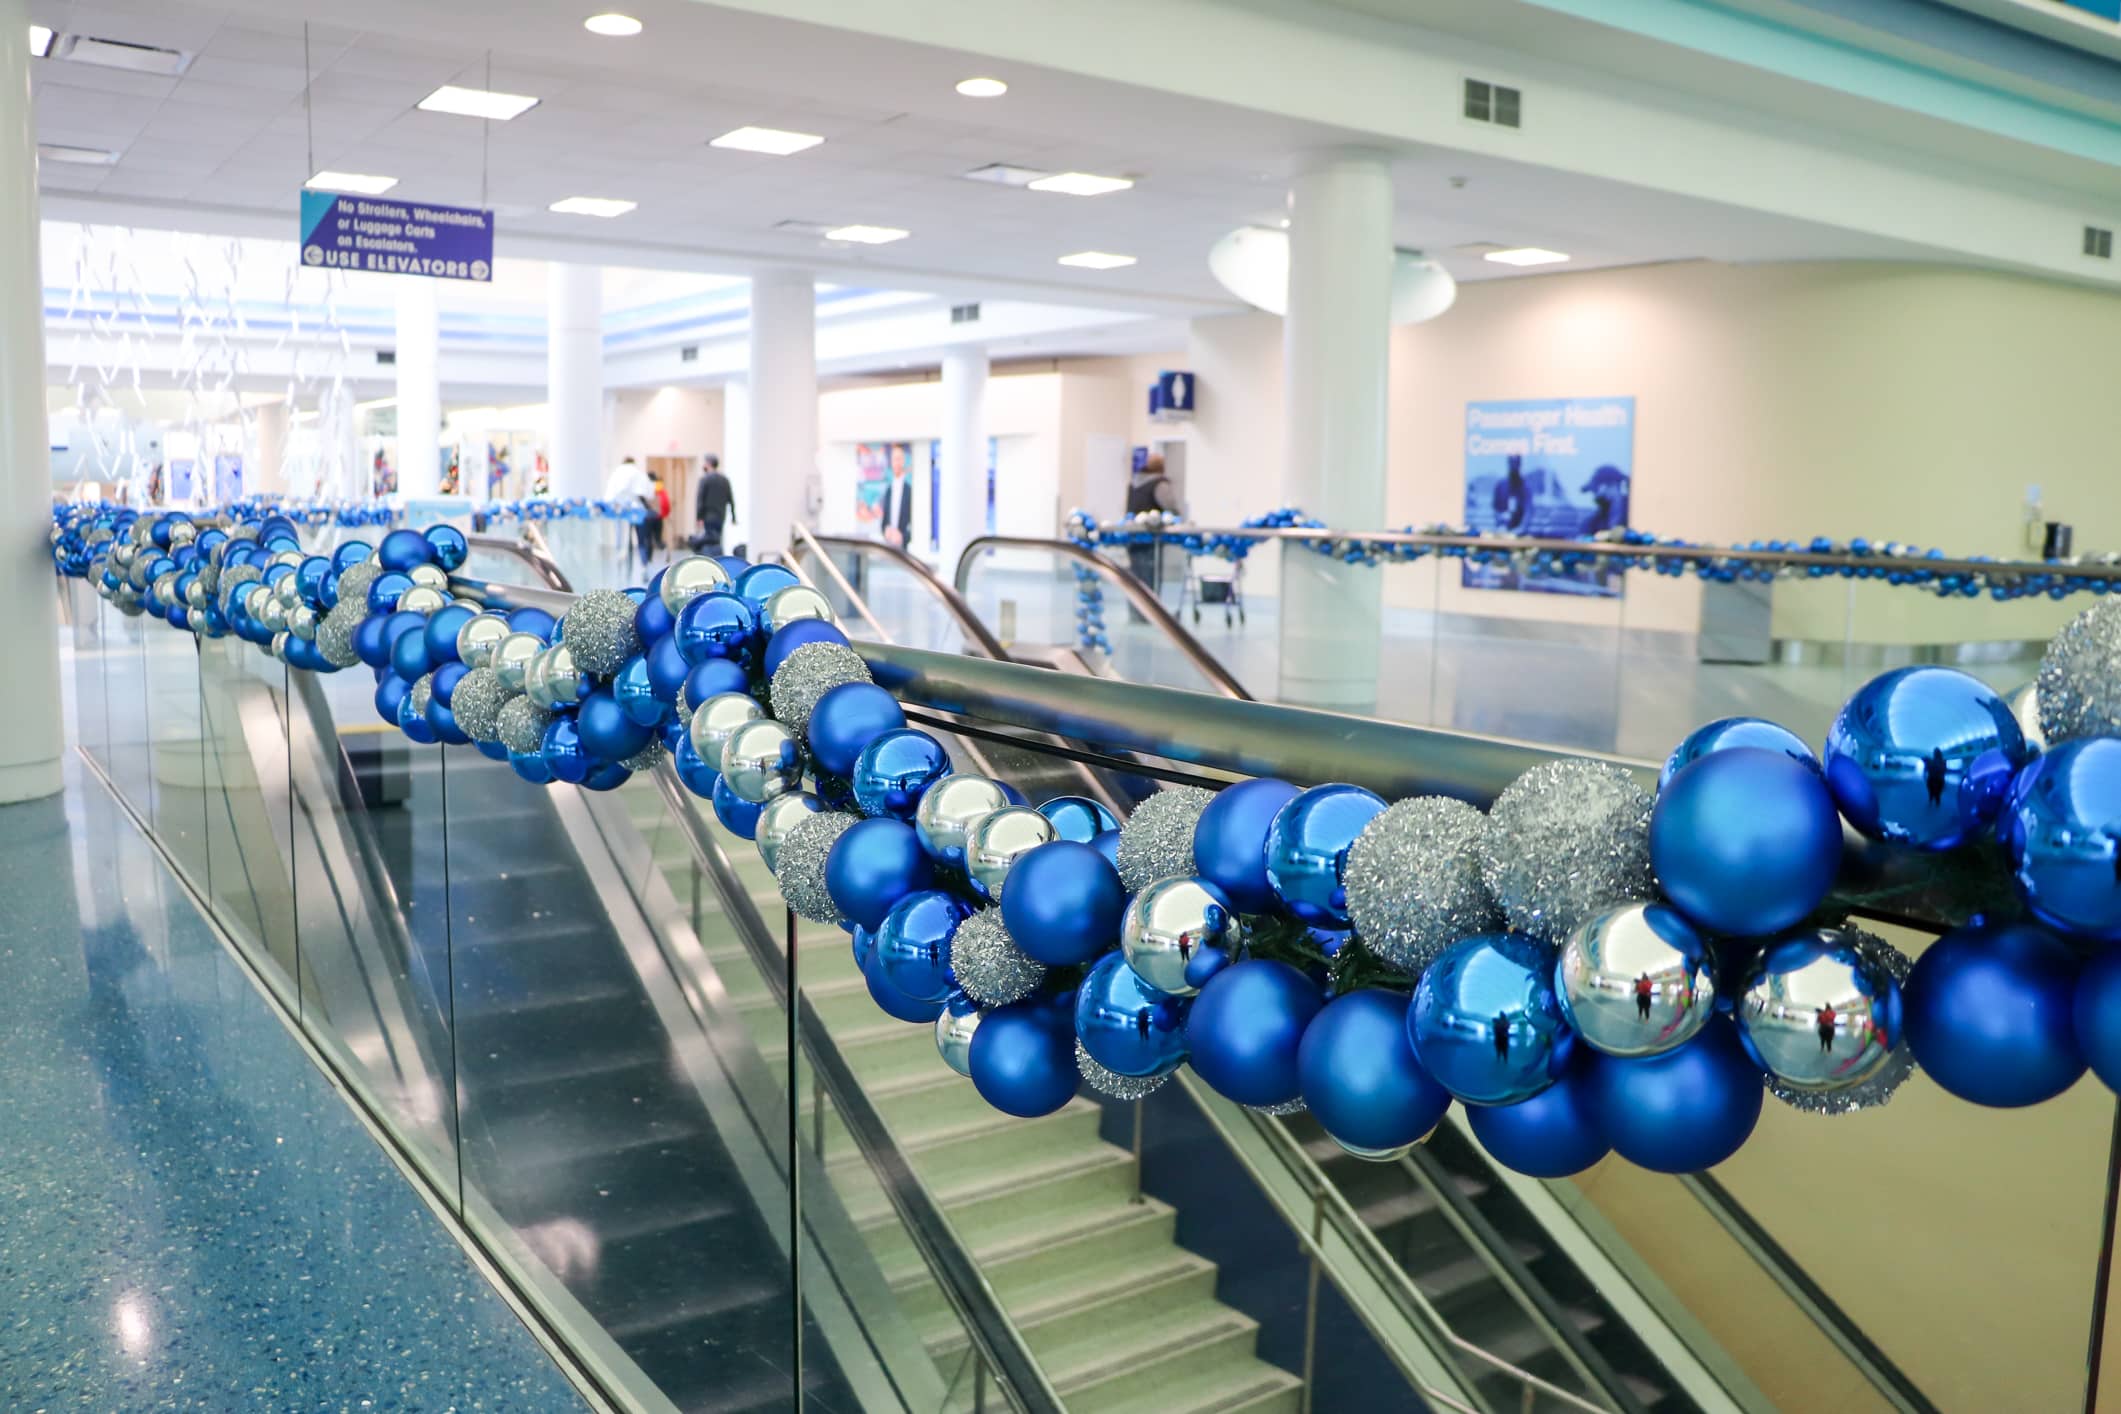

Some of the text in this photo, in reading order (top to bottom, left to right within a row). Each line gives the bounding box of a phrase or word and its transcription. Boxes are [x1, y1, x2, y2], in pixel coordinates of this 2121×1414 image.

[337, 199, 486, 229] No Strollers, Wheelchairs,
[337, 217, 436, 239] or Luggage Carts
[337, 235, 352, 247] on
[325, 249, 468, 278] USE ELEVATORS
